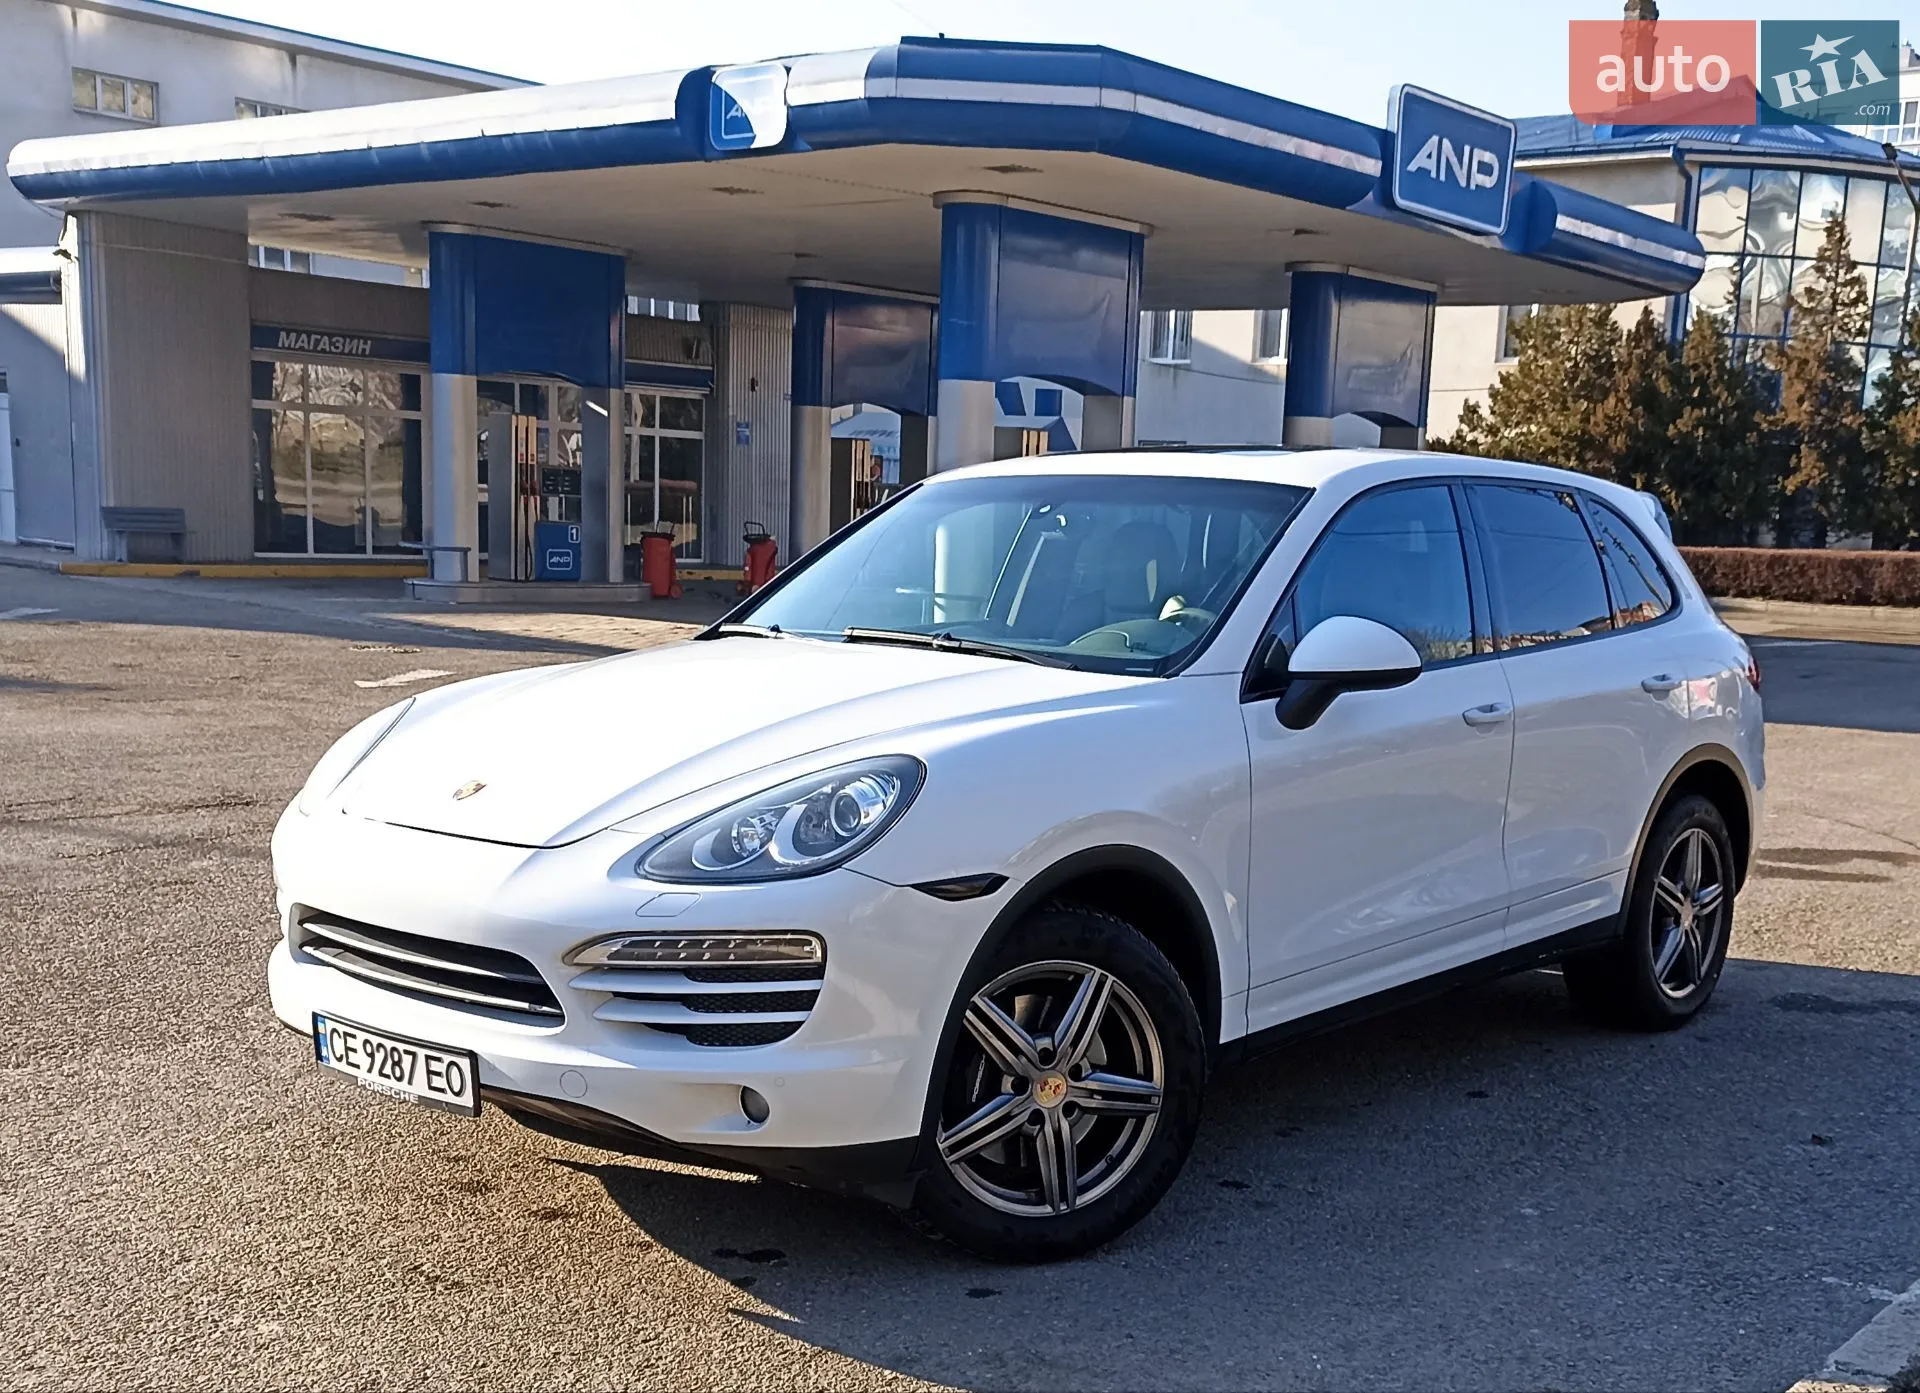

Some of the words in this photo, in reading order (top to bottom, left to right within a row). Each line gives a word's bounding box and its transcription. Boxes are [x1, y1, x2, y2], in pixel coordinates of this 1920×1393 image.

[1406, 134, 1500, 191] ANP
[278, 330, 372, 355] МАГАЗИН
[329, 1027, 360, 1069] CE
[362, 1038, 418, 1086] 9287
[424, 1053, 467, 1098] EO
[357, 1077, 419, 1104] PORSCHE
